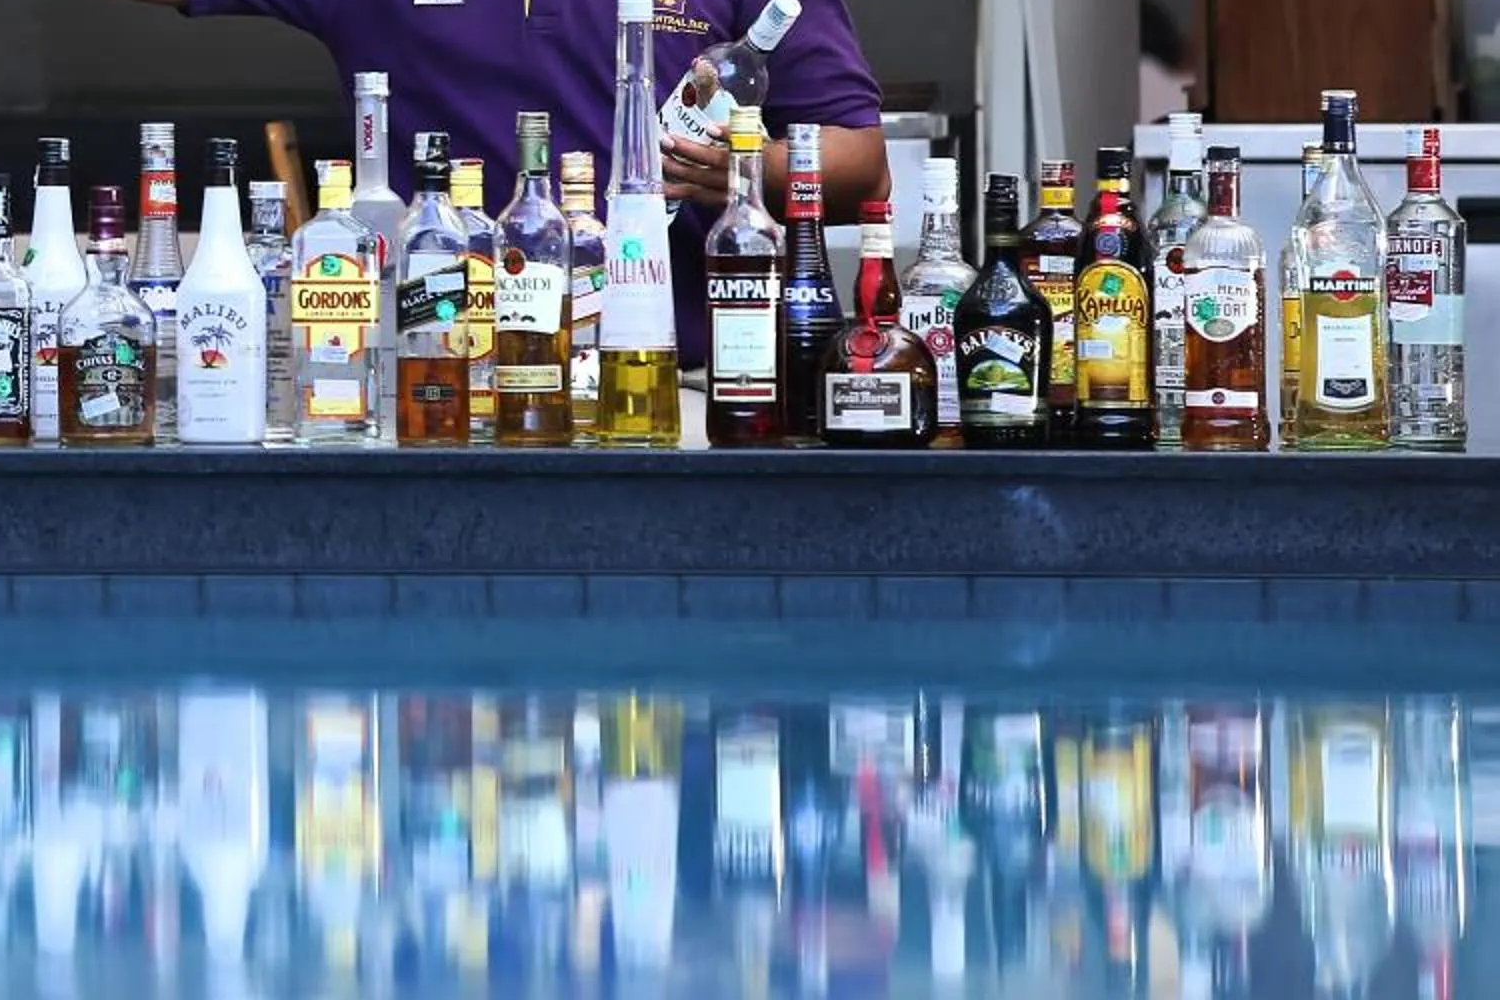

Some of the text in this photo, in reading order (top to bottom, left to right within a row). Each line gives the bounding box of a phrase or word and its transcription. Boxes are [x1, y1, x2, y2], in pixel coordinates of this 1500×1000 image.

[363, 113, 373, 152] VODKA
[608, 258, 667, 286] ALLIANO
[496, 276, 551, 291] ACARDI
[708, 279, 780, 299] CAMPA
[1312, 280, 1374, 292] MARTINI
[784, 287, 834, 303] BOLS
[180, 303, 248, 330] MALIBU
[935, 306, 954, 325] BE
[1191, 302, 1248, 317] CFORT
[960, 330, 1034, 356] BAIEYS
